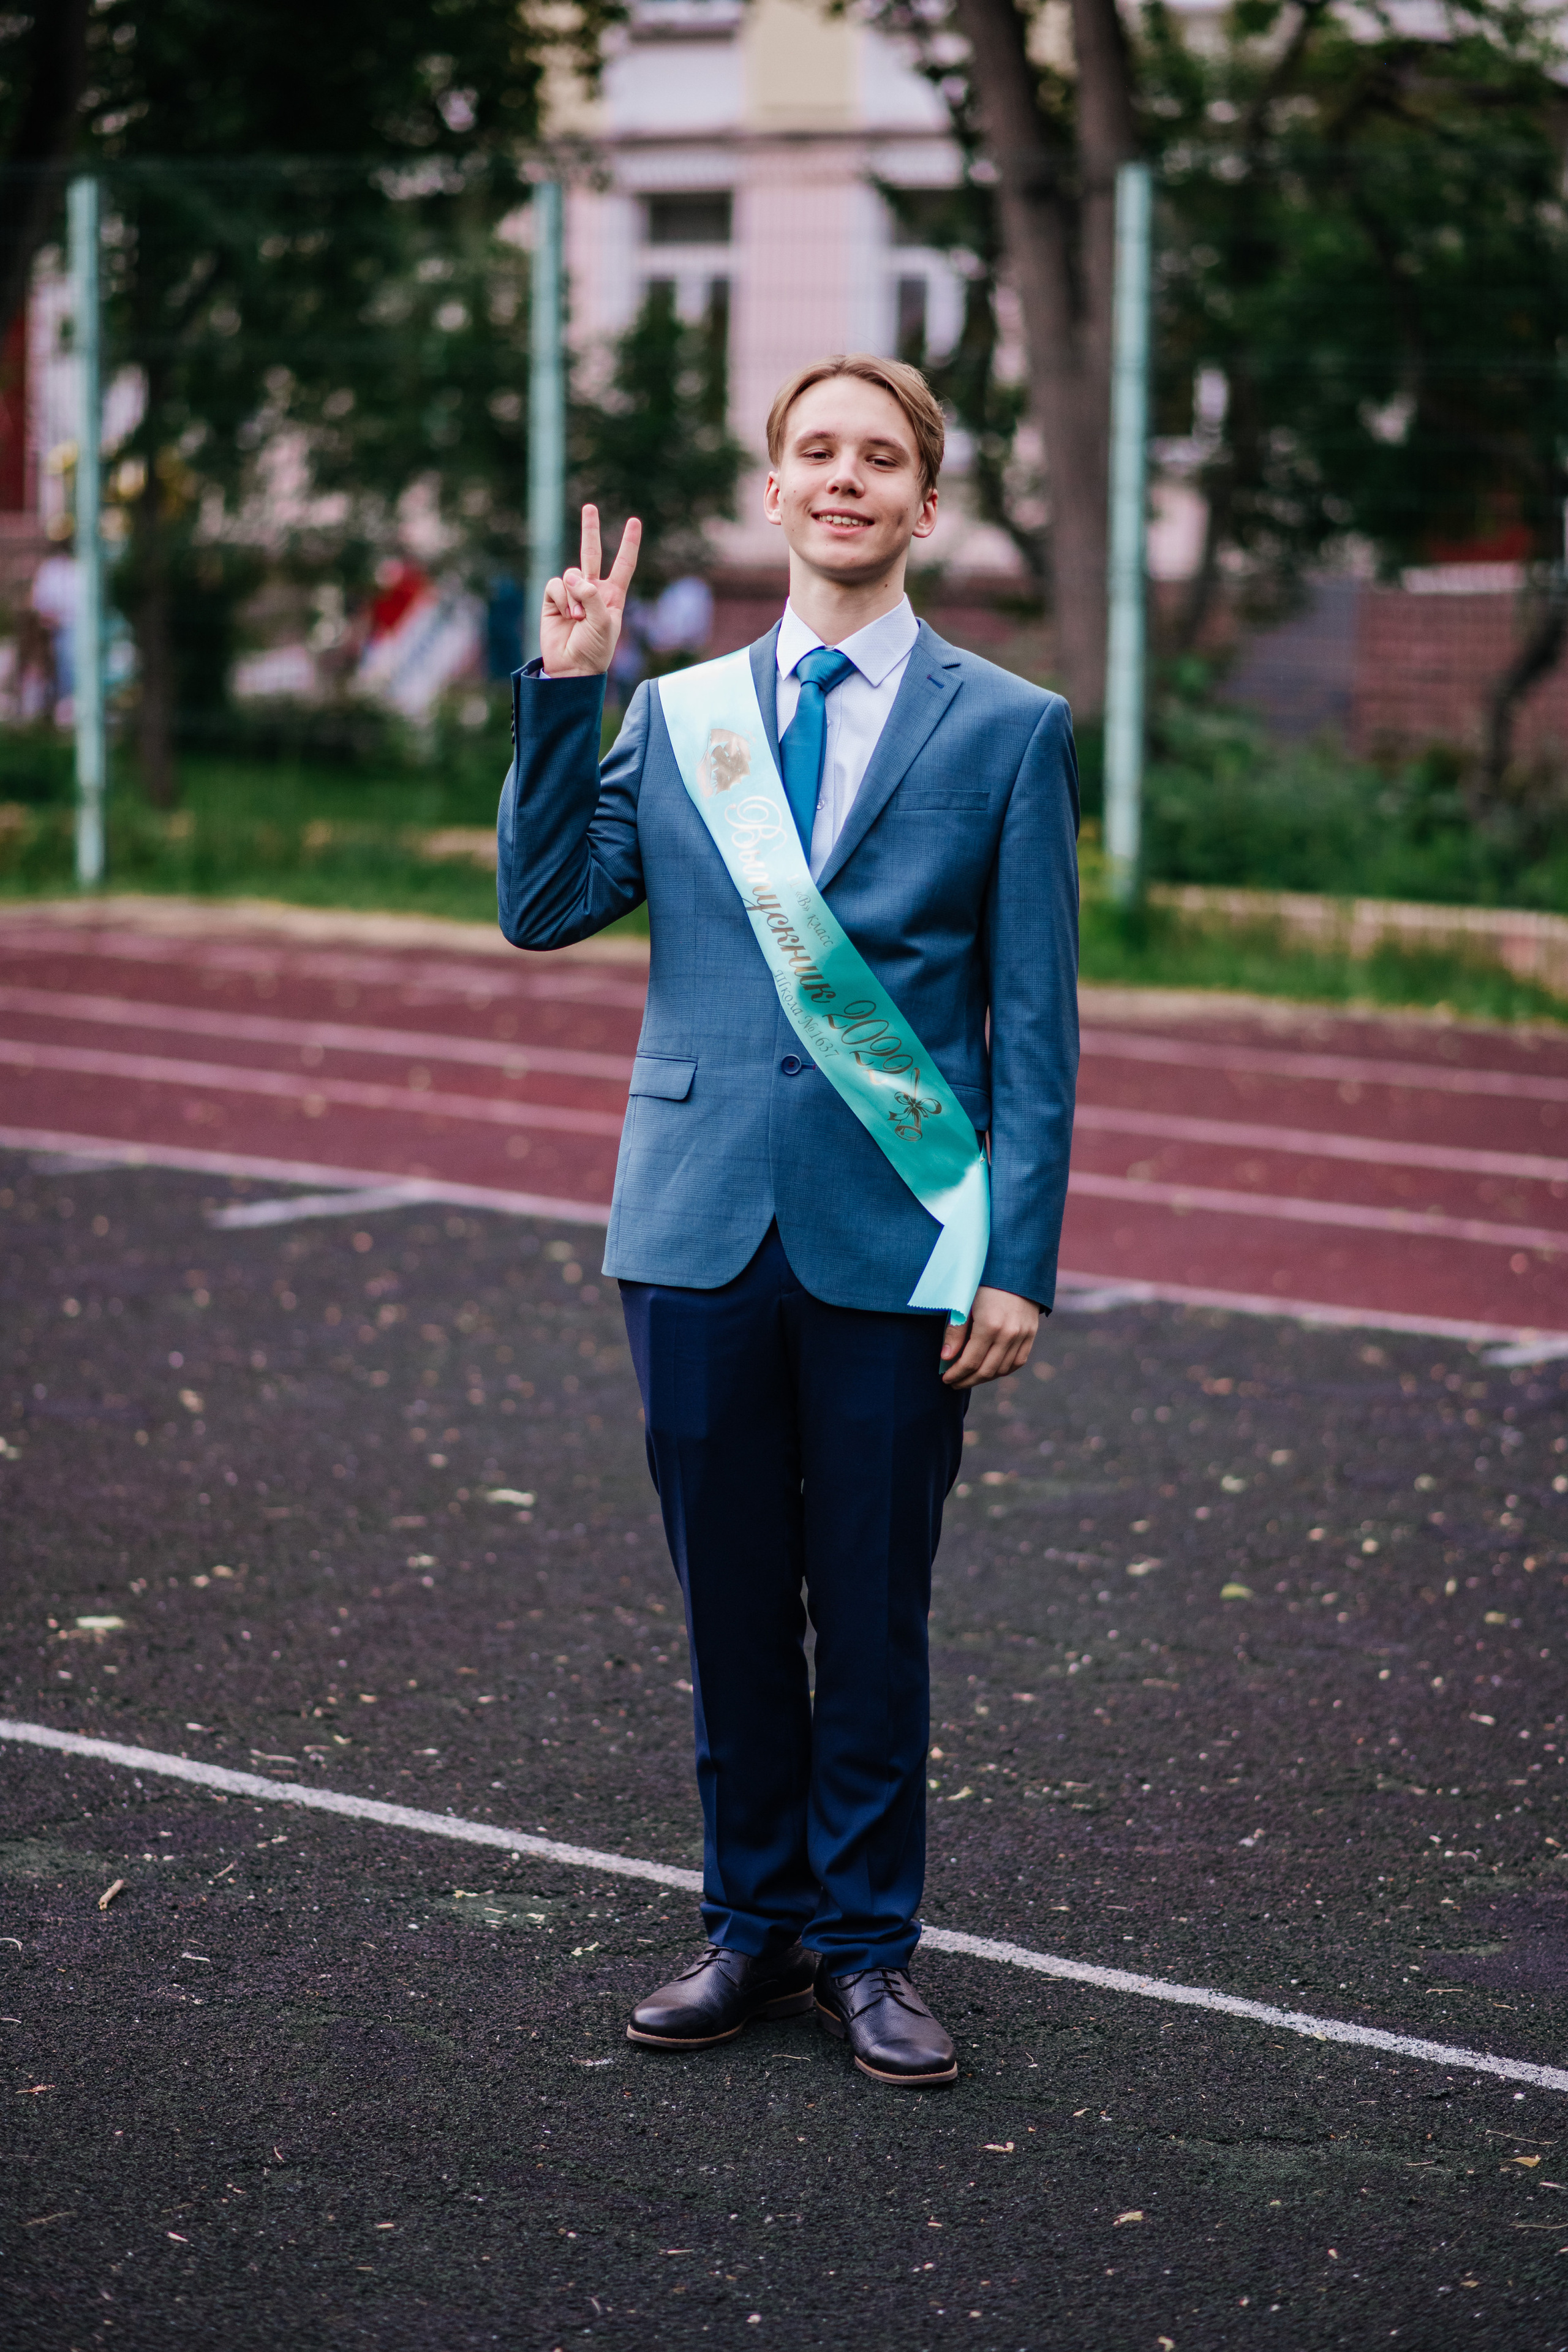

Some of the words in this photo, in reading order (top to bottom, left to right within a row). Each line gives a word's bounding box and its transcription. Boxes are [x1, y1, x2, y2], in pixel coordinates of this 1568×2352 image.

[724, 796, 836, 1003] Выпускник
[822, 1000, 913, 1085] 2022
[807, 914, 833, 947] класс
[774, 970, 803, 1016] Школа
